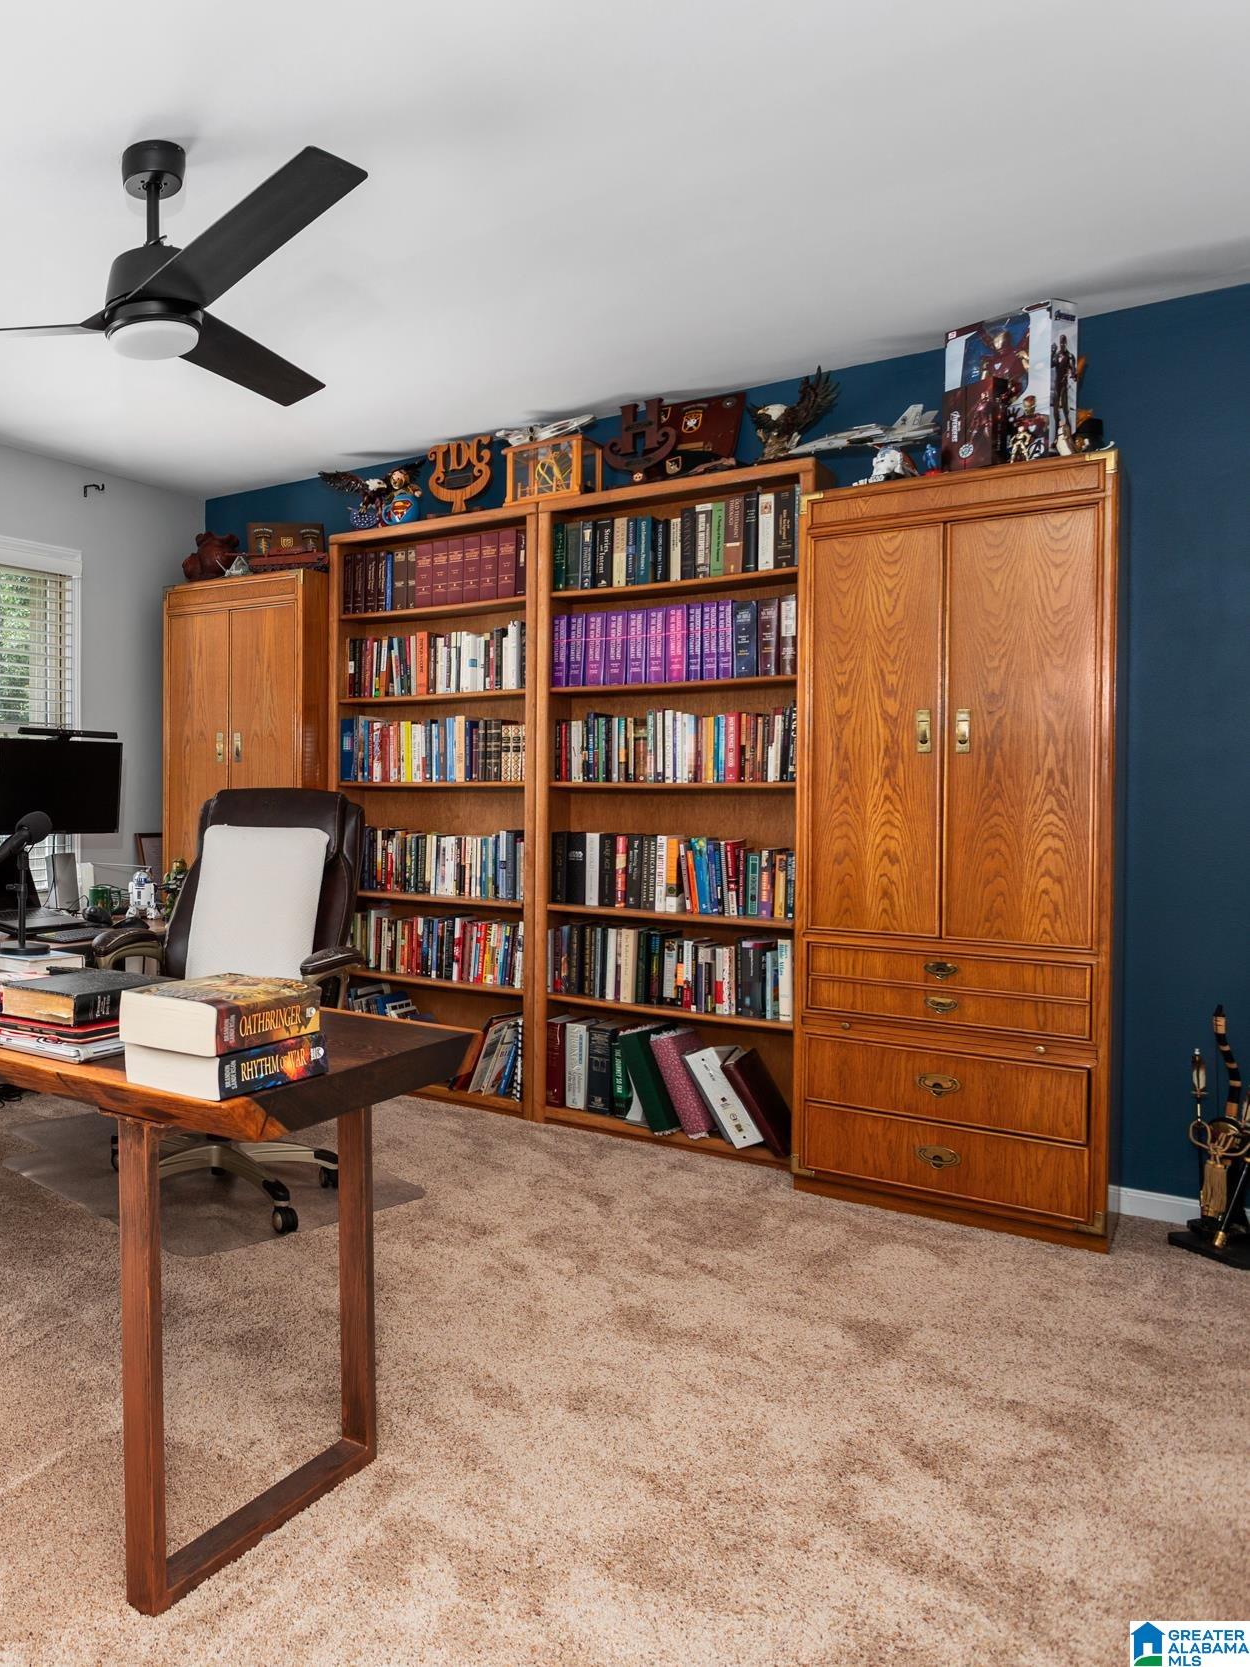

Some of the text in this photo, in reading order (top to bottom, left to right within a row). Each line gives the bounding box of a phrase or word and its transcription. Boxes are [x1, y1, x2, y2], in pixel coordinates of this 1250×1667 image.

[239, 1005, 301, 1038] OATHBRINGER
[241, 1055, 280, 1081] RHYTHM
[288, 1048, 307, 1067] WAR
